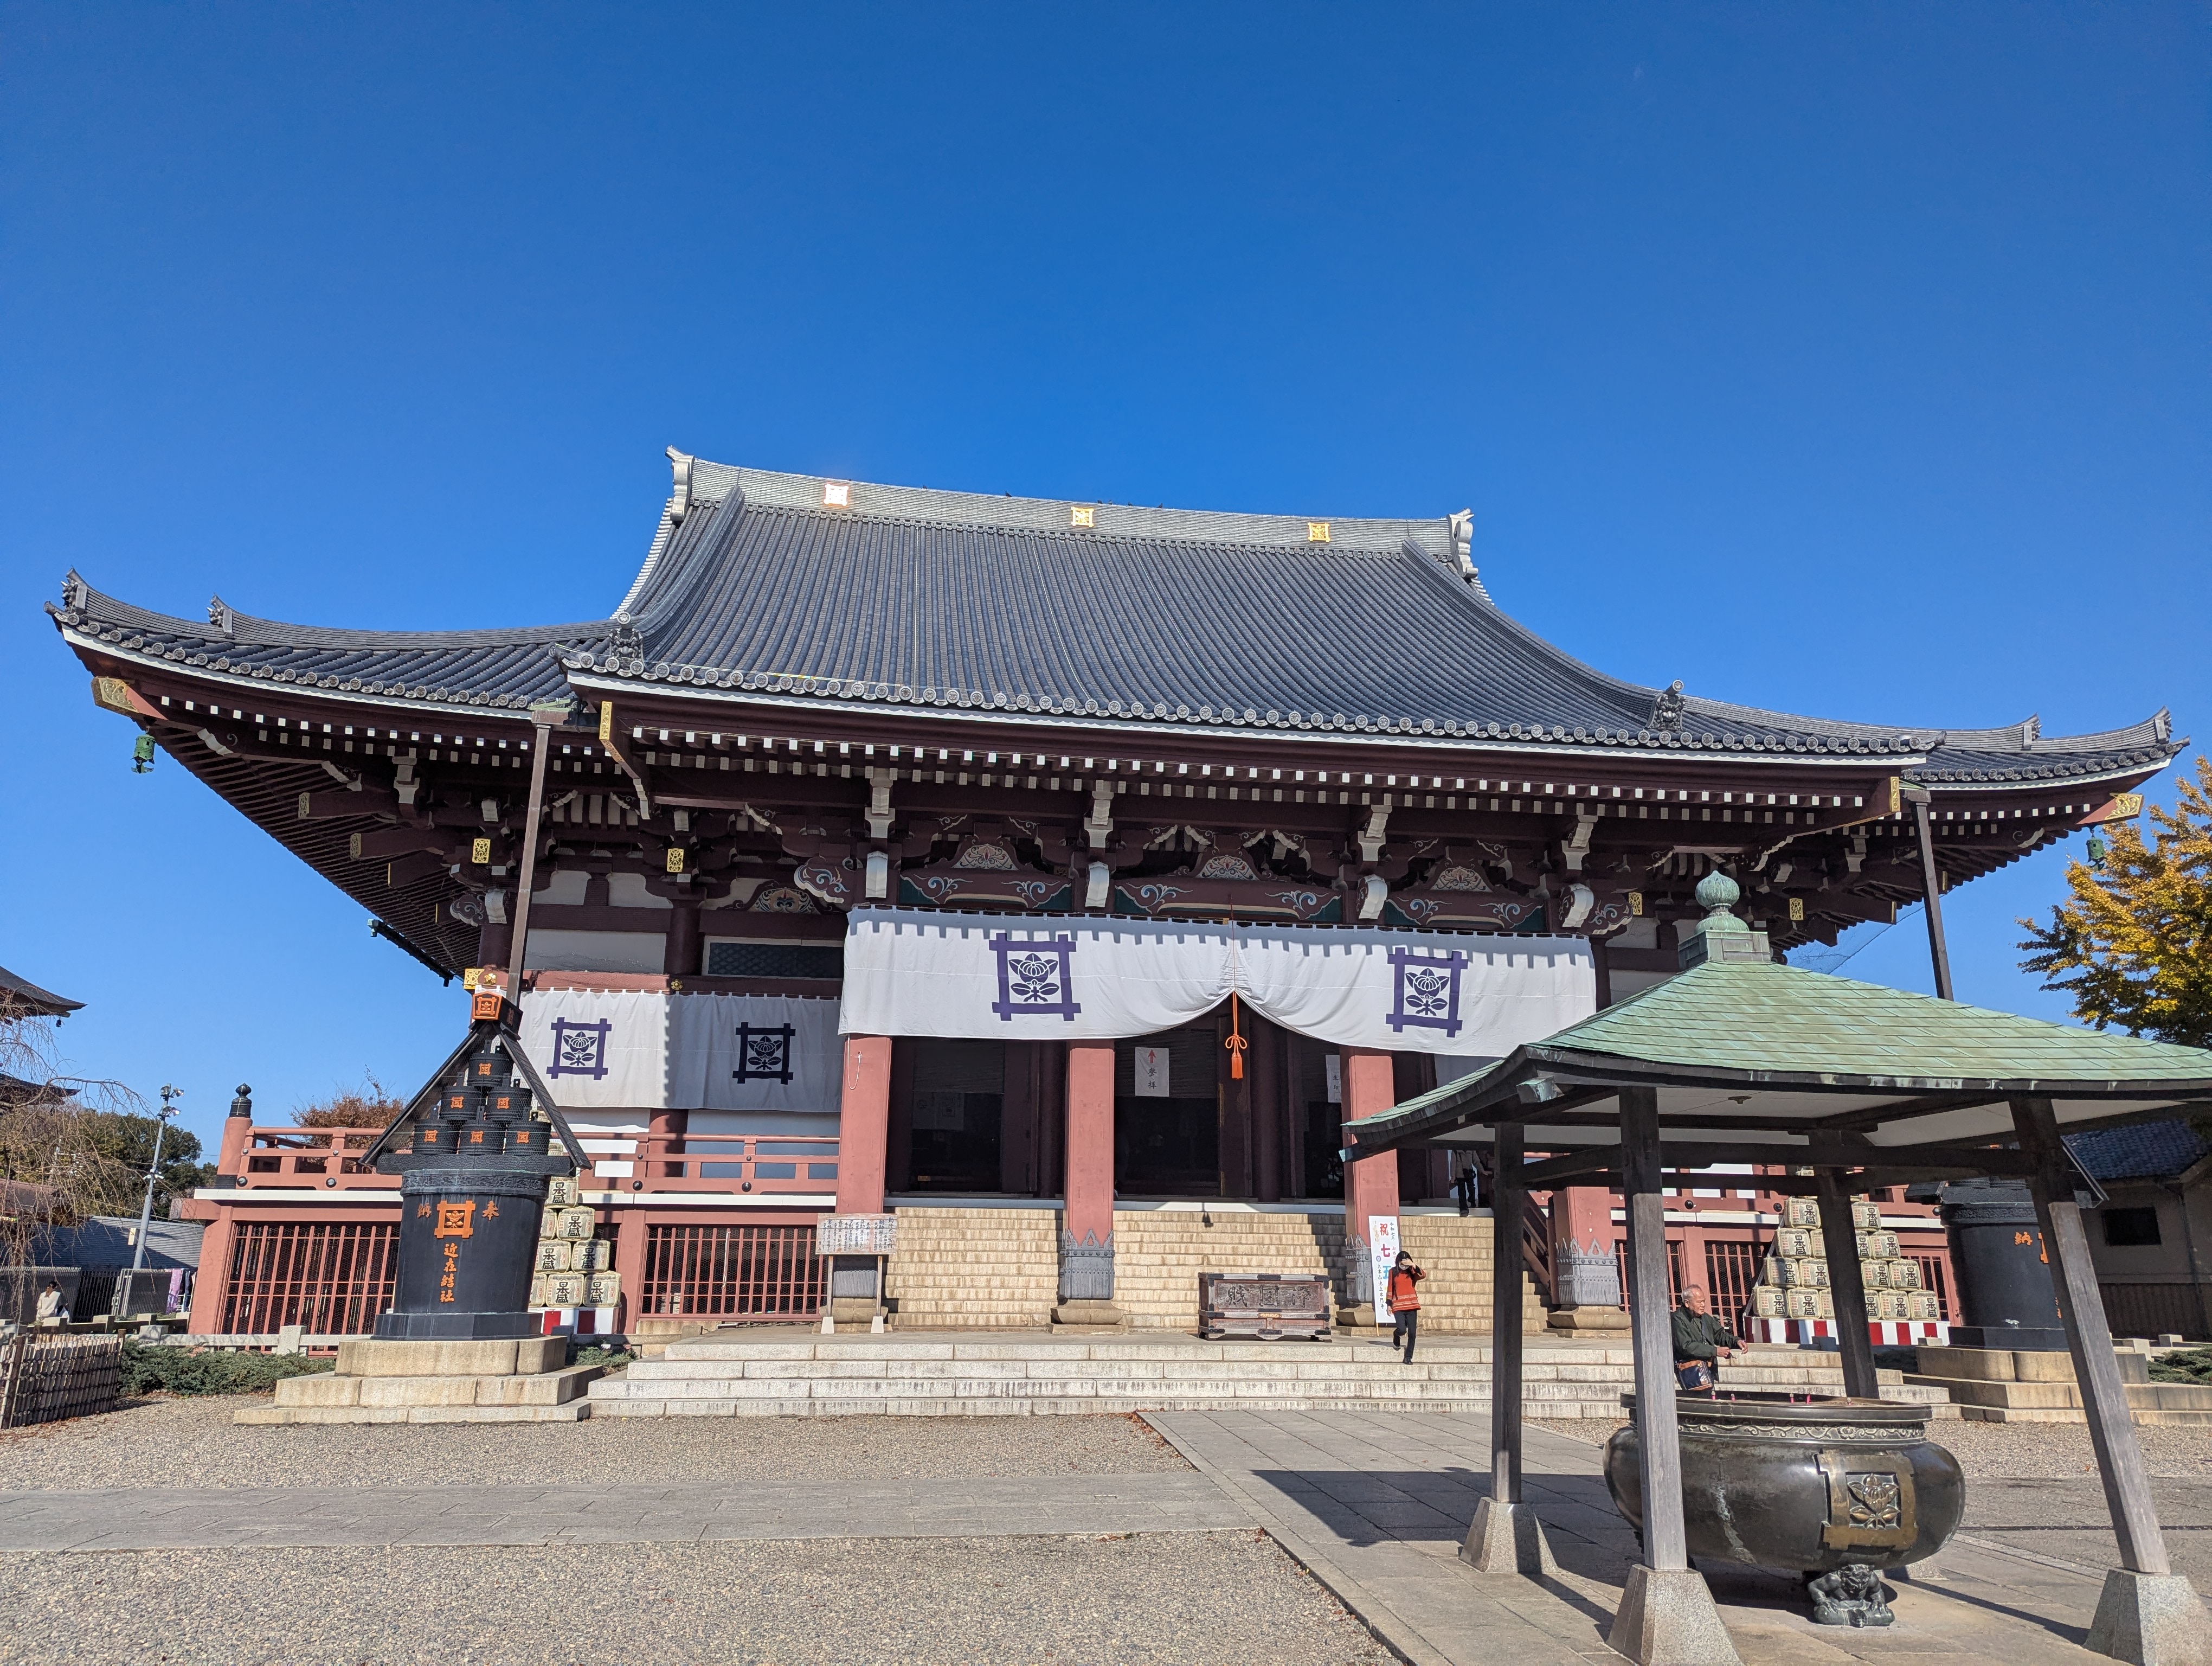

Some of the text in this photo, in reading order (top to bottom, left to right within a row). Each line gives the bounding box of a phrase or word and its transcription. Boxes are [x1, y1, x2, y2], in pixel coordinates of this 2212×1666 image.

[552, 1182, 566, 1204] 日本盛
[482, 1200, 499, 1221] 奉
[1804, 1205, 1816, 1225] 日本盛
[1866, 1208, 1878, 1227] 日本盛
[567, 1215, 582, 1237] 日本盛
[1794, 1235, 1806, 1255] 日本盛
[1858, 1237, 1869, 1257] 日本盛
[1887, 1237, 1899, 1257] 日本盛
[542, 1248, 556, 1270] 日本盛
[581, 1247, 596, 1270] 日本盛
[440, 1242, 459, 1303] 近在結社
[1784, 1264, 1796, 1284] 日本盛
[1815, 1266, 1827, 1286] 日本盛
[1877, 1266, 1888, 1286] 日本盛
[1905, 1267, 1918, 1287] 日本盛
[556, 1281, 570, 1304] 日本盛
[590, 1281, 603, 1304] 日本盛
[1773, 1295, 1785, 1315] 日本盛
[1803, 1296, 1816, 1316] 日本盛
[1866, 1297, 1877, 1317] 日本盛
[1895, 1297, 1907, 1317] 日本盛
[1926, 1297, 1938, 1318] 日本盛
